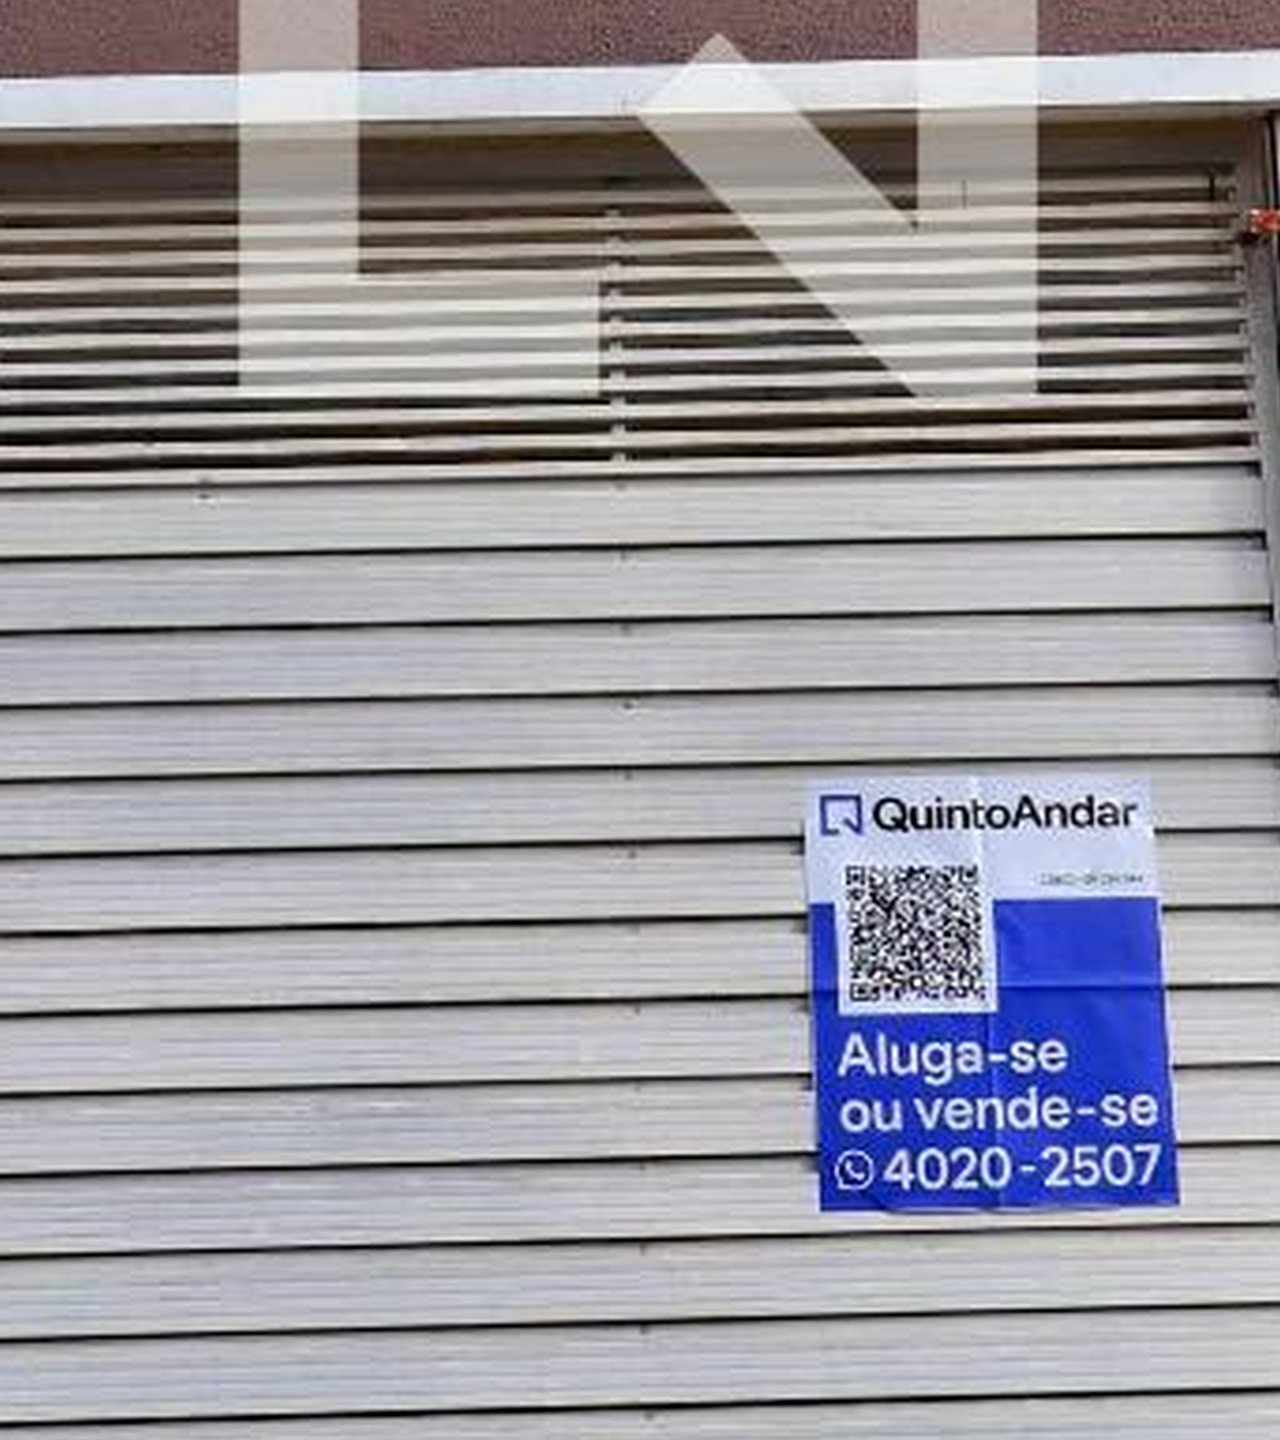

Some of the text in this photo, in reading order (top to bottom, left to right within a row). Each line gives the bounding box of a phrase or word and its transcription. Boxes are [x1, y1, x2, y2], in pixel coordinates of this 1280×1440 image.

[872, 794, 1137, 833] QuintoAndar
[837, 1032, 1068, 1086] Aluga-se
[839, 1085, 1159, 1133] ou vende-se
[882, 1143, 1162, 1191] 4020-2507
